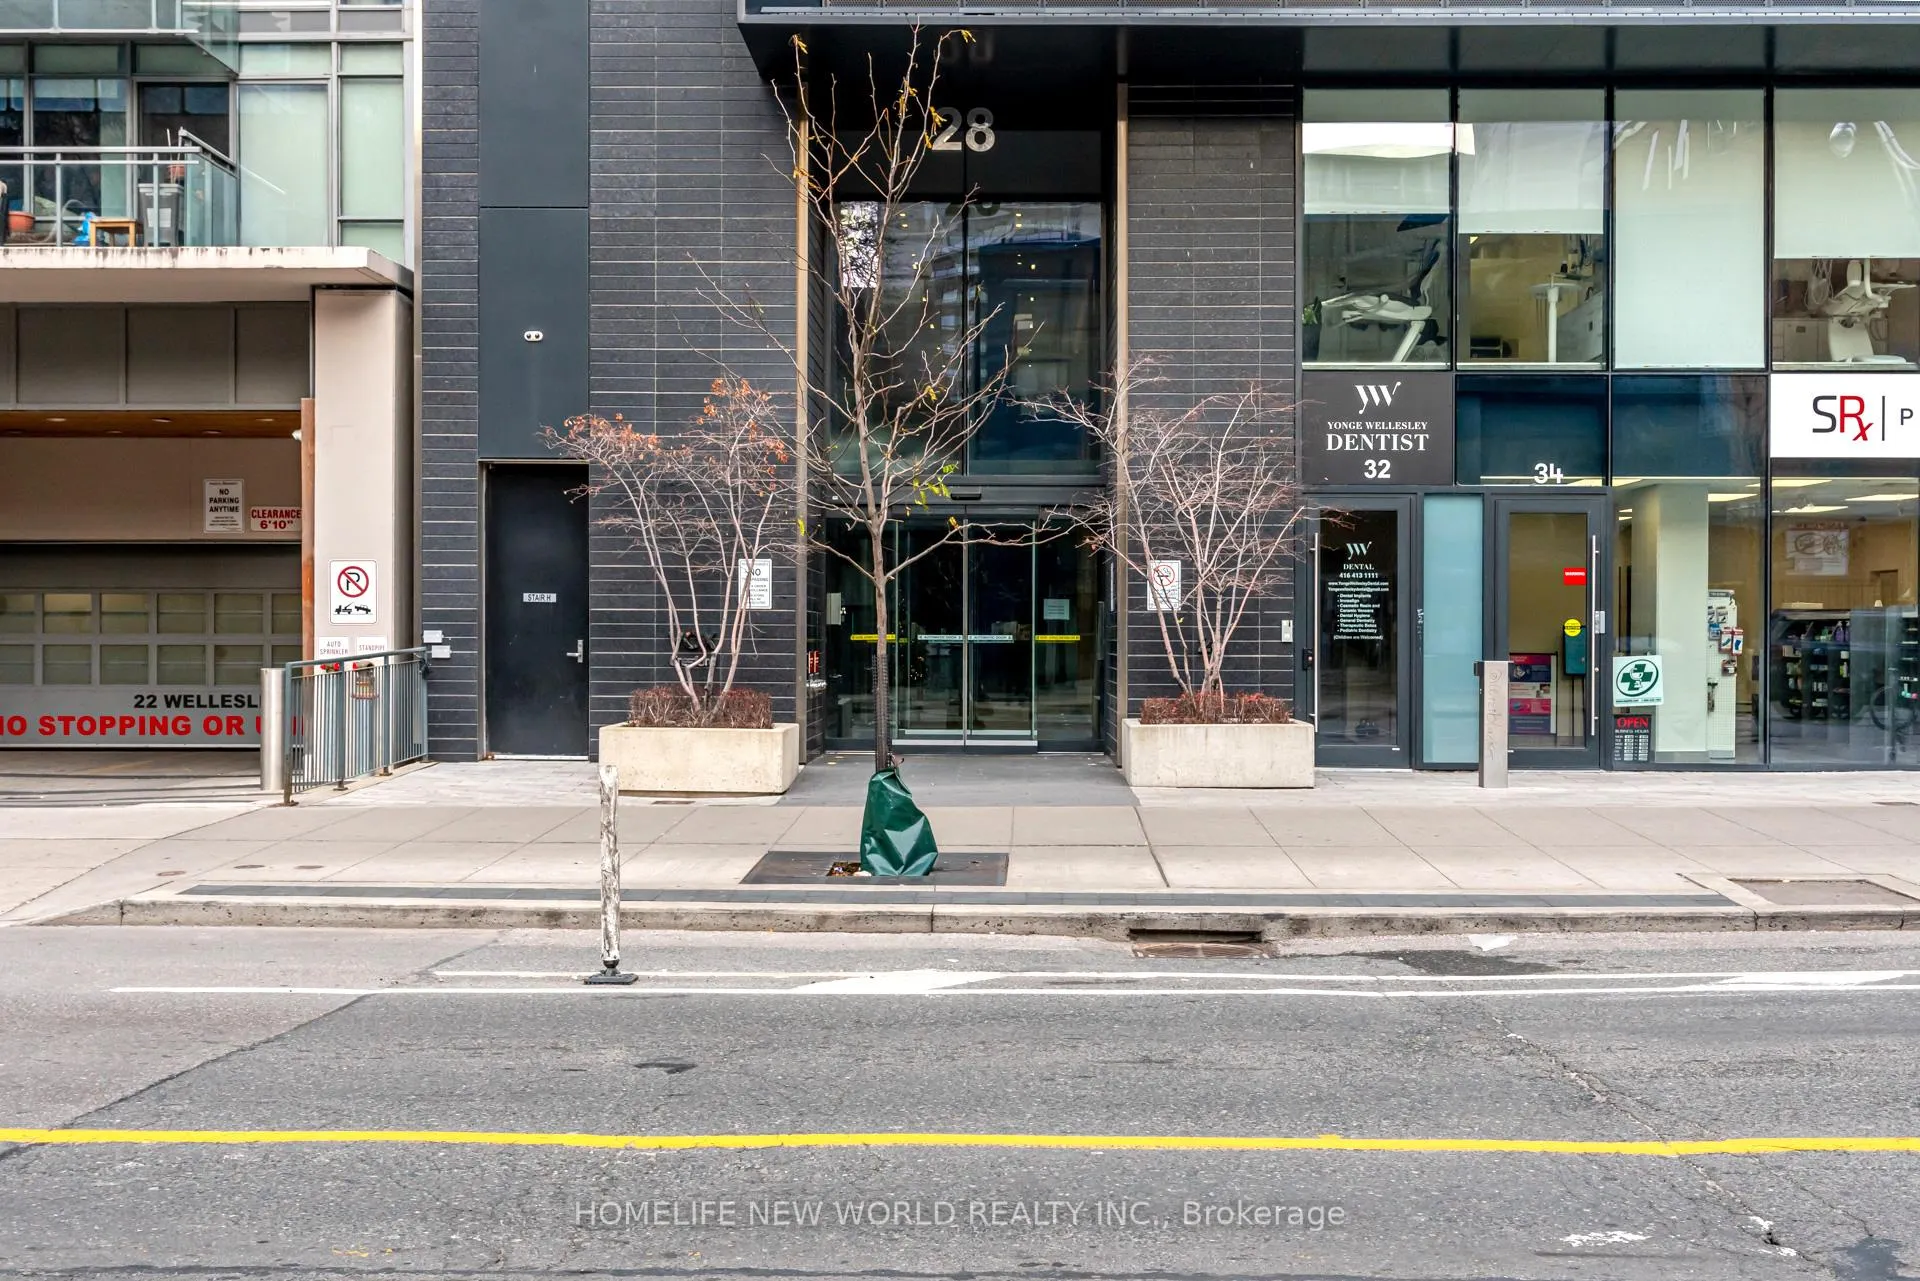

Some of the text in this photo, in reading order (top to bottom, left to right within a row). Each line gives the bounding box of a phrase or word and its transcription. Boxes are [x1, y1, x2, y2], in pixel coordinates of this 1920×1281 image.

[931, 107, 996, 152] 28
[1327, 421, 1428, 430] YONGE WELLESLEY
[1326, 433, 1430, 451] DENTIST
[1363, 459, 1391, 479] 32
[1534, 463, 1564, 484] 34
[219, 488, 230, 496] NO
[251, 509, 302, 519] CLEARANCE
[260, 520, 294, 529] 6'10"
[134, 695, 262, 708] 22 WELLESL
[38, 715, 192, 736] STOPPING
[203, 715, 245, 736] OR
[1616, 717, 1649, 728] OPEN
